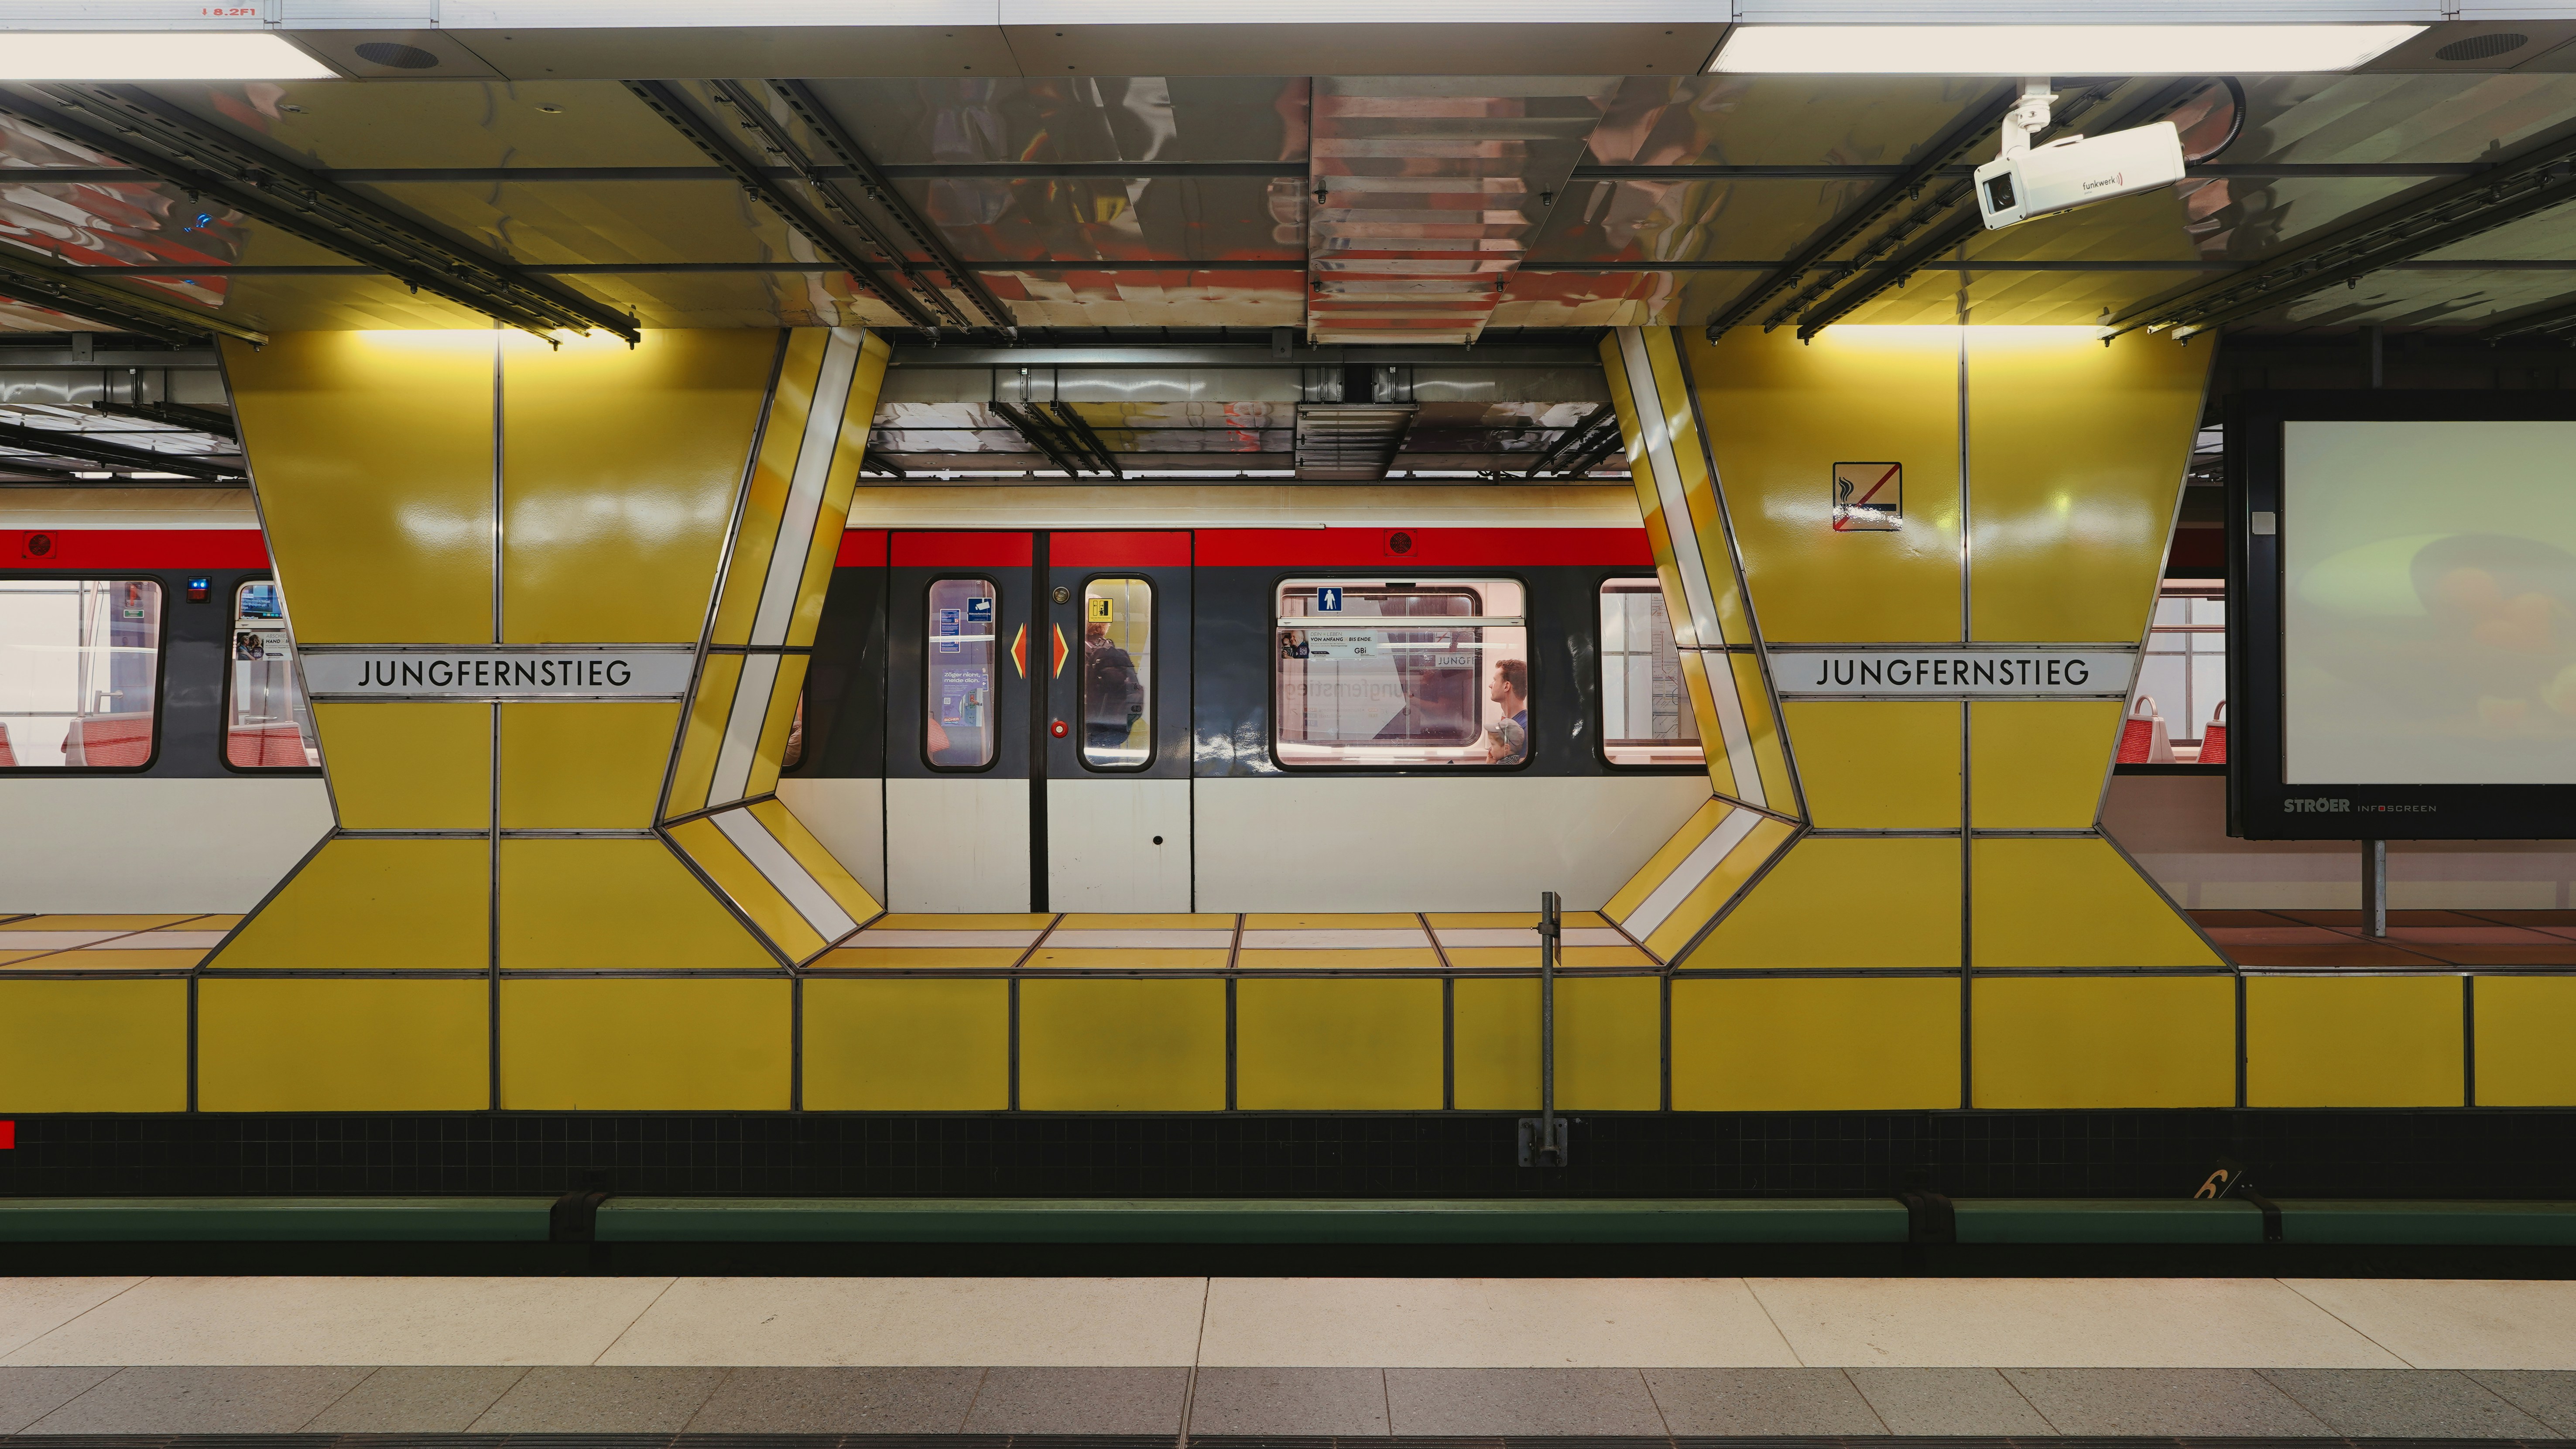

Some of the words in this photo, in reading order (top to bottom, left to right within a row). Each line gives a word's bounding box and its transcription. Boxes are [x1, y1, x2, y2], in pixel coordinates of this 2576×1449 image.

[2083, 176, 2116, 190] funkwerk
[358, 660, 631, 686] JUNGFERNSTIEG
[1816, 659, 2089, 685] JUNGFERNSTIEG
[2284, 798, 2350, 812] STRÖER
